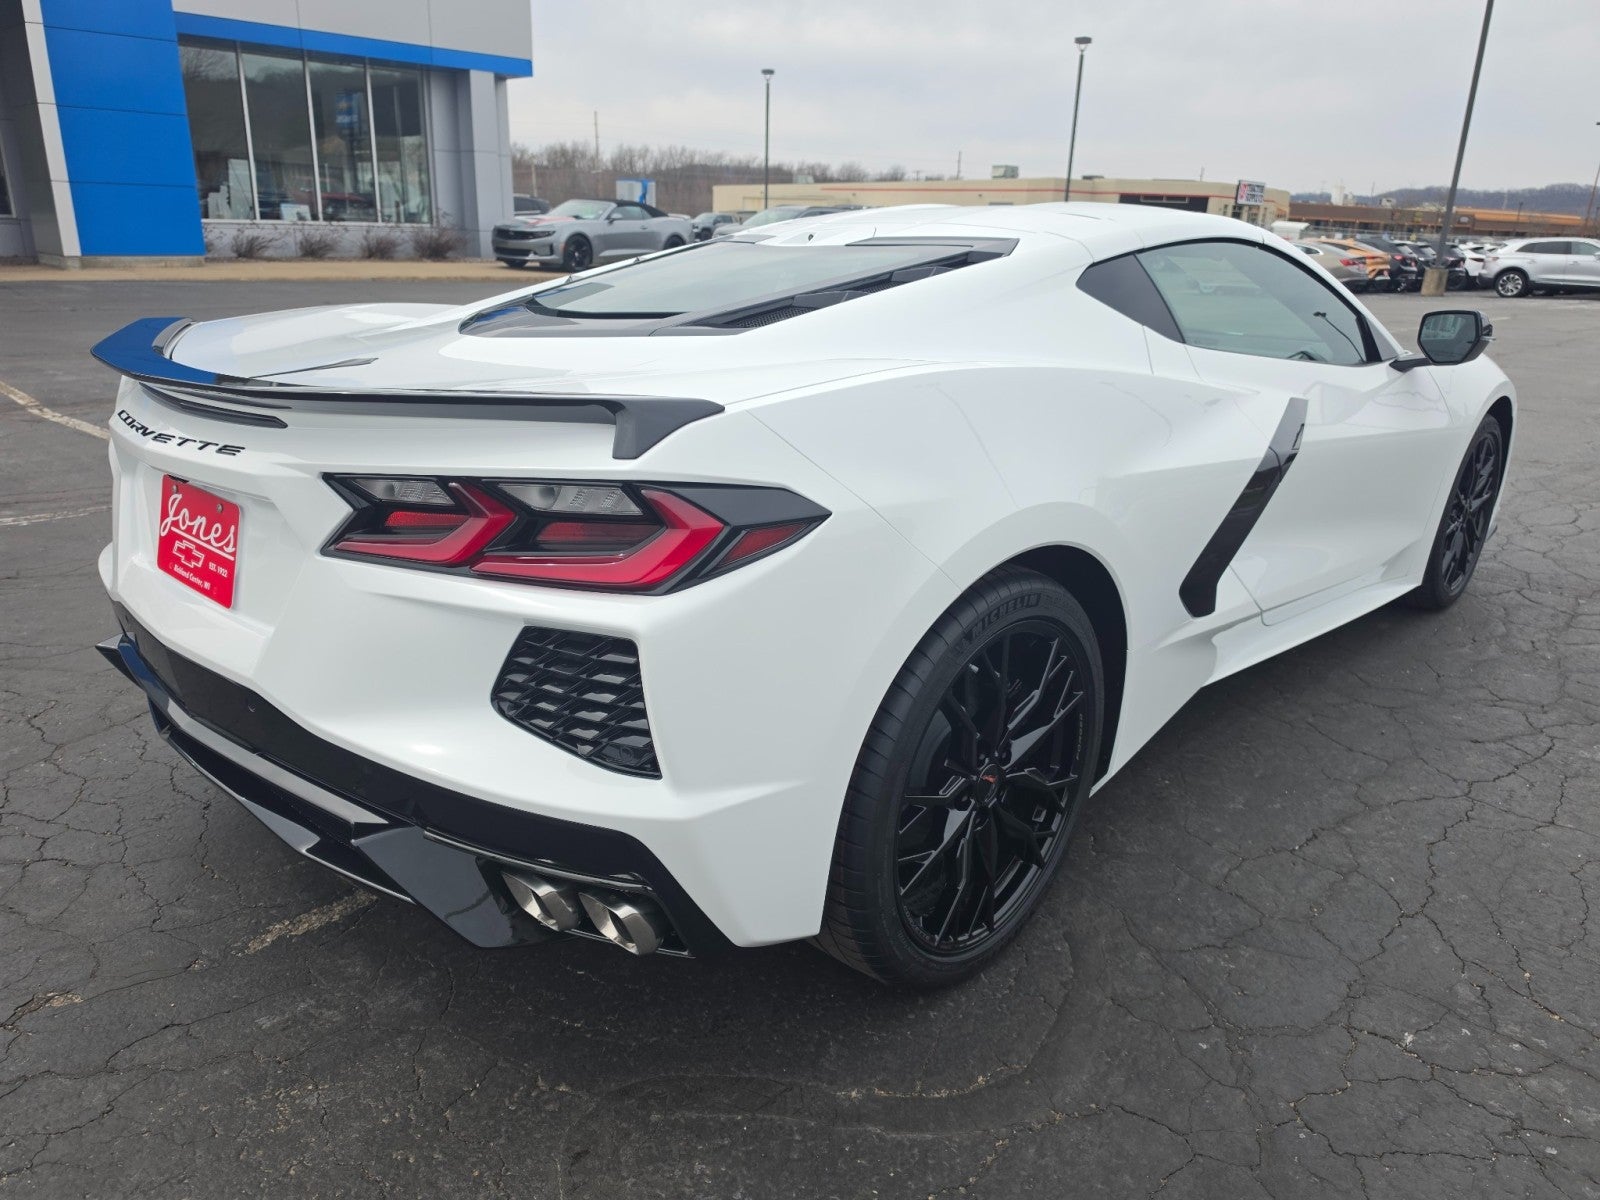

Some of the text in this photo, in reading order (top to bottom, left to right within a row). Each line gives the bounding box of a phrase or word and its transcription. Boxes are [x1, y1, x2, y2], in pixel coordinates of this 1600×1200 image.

[117, 409, 246, 456] CORVETTE
[160, 493, 236, 551] Jones
[968, 593, 1042, 639] MICHELIN
